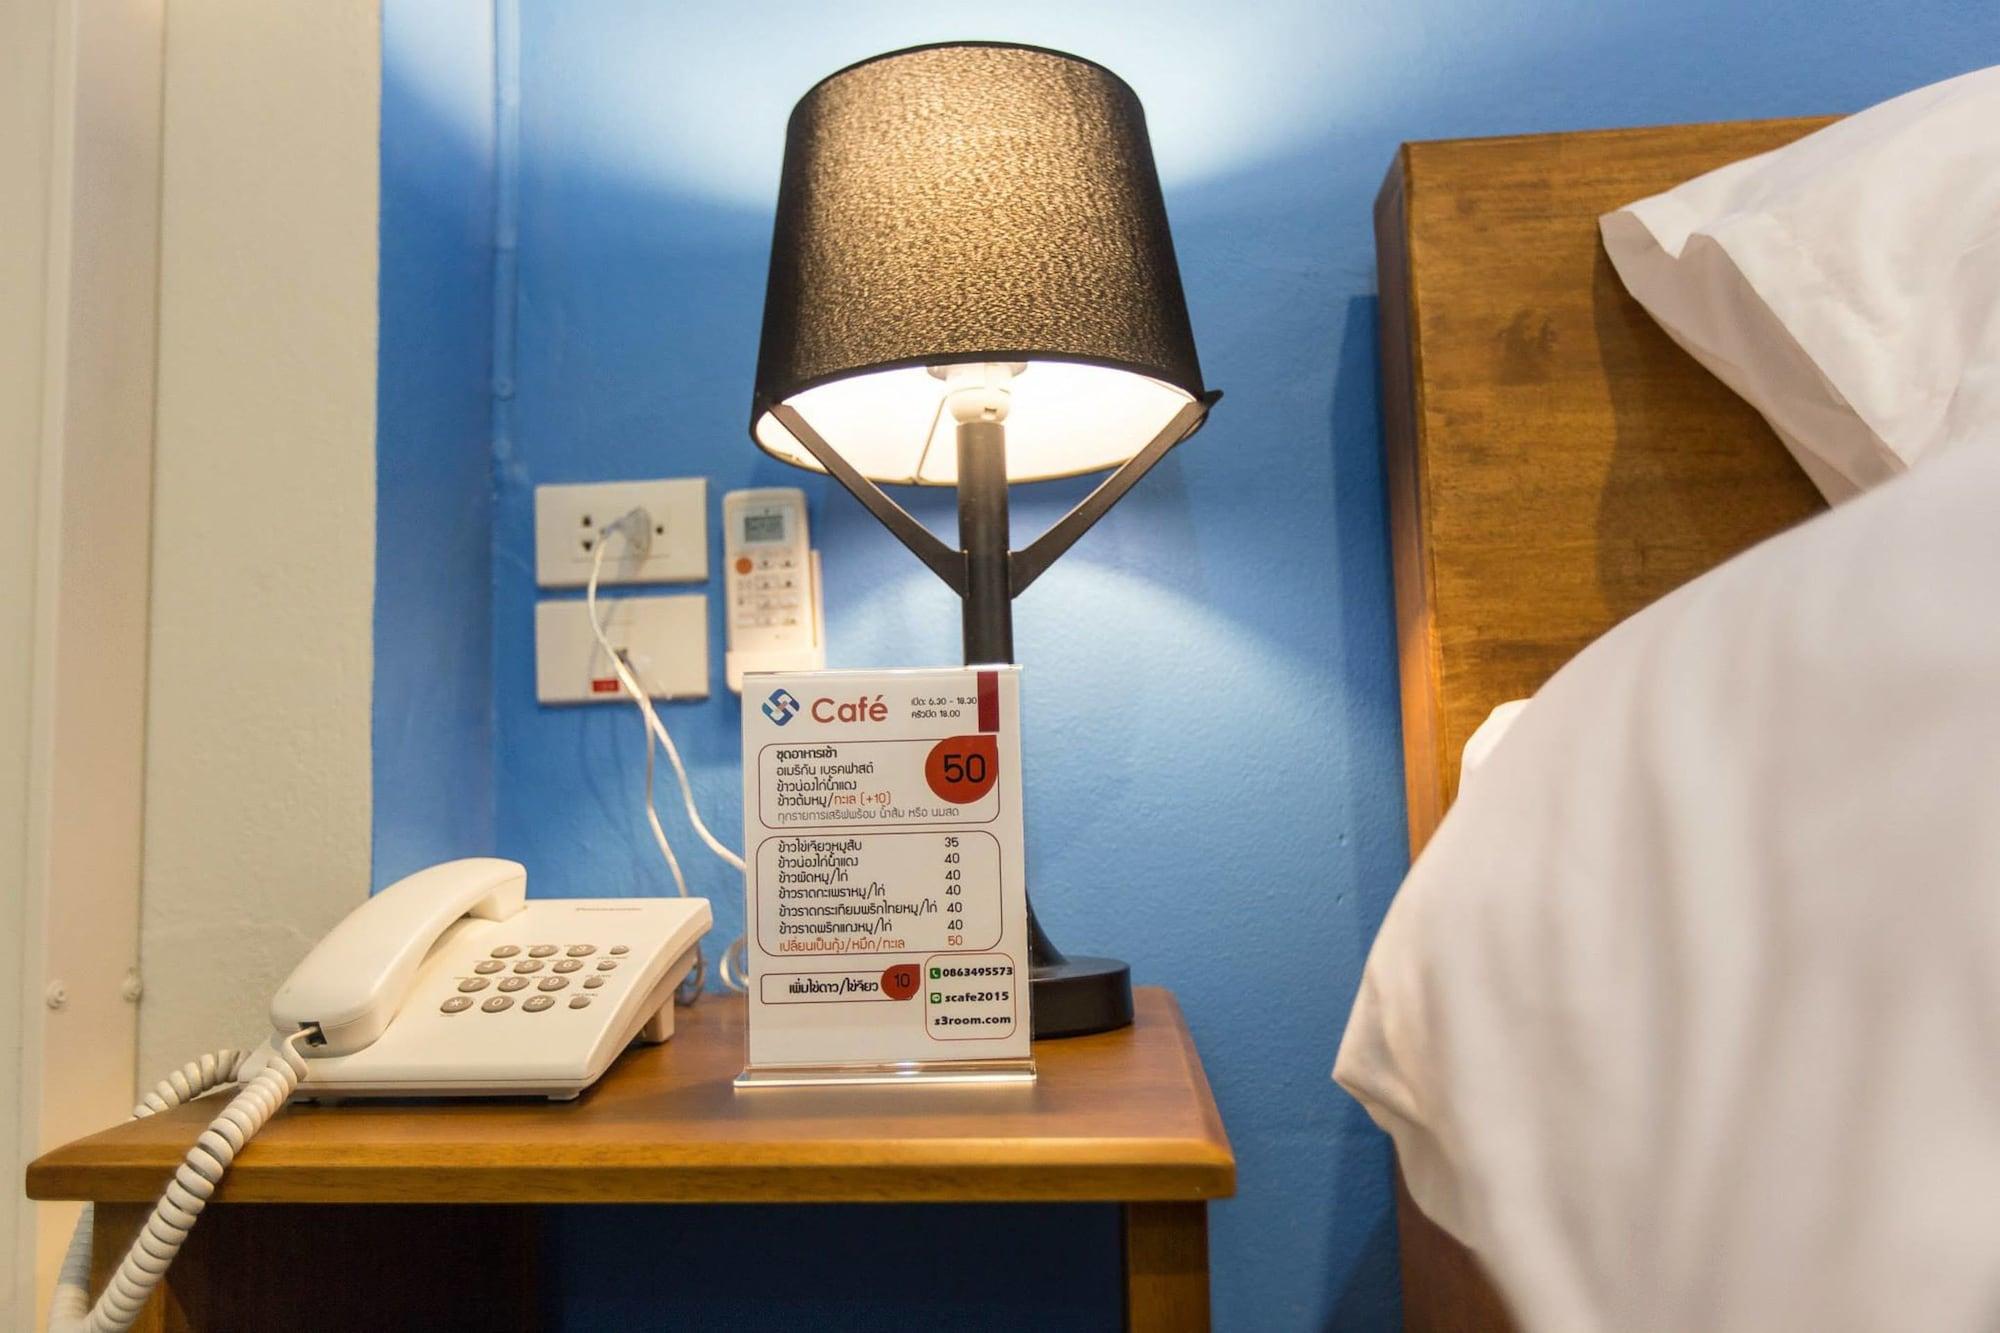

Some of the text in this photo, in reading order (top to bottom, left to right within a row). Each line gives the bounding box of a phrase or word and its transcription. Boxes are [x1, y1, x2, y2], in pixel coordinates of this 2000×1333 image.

[929, 697, 947, 705] 6.30
[811, 695, 888, 723] Café
[776, 746, 838, 762] ชุดอาหารเช้า
[776, 764, 816, 776] อเมริกัน
[943, 754, 986, 783] 50
[944, 837, 959, 847] 35
[944, 853, 960, 864] 40
[945, 870, 961, 880] 40
[945, 885, 961, 895] 40
[947, 902, 962, 913] 40
[947, 920, 963, 930] 40
[948, 935, 963, 945] 50
[943, 967, 1012, 977] 0863495573
[549, 978, 558, 986] 9
[894, 973, 910, 988] 10
[945, 992, 1009, 1002] scafe2015
[493, 998, 503, 1007] 0
[935, 1016, 1011, 1025] s3room.com
